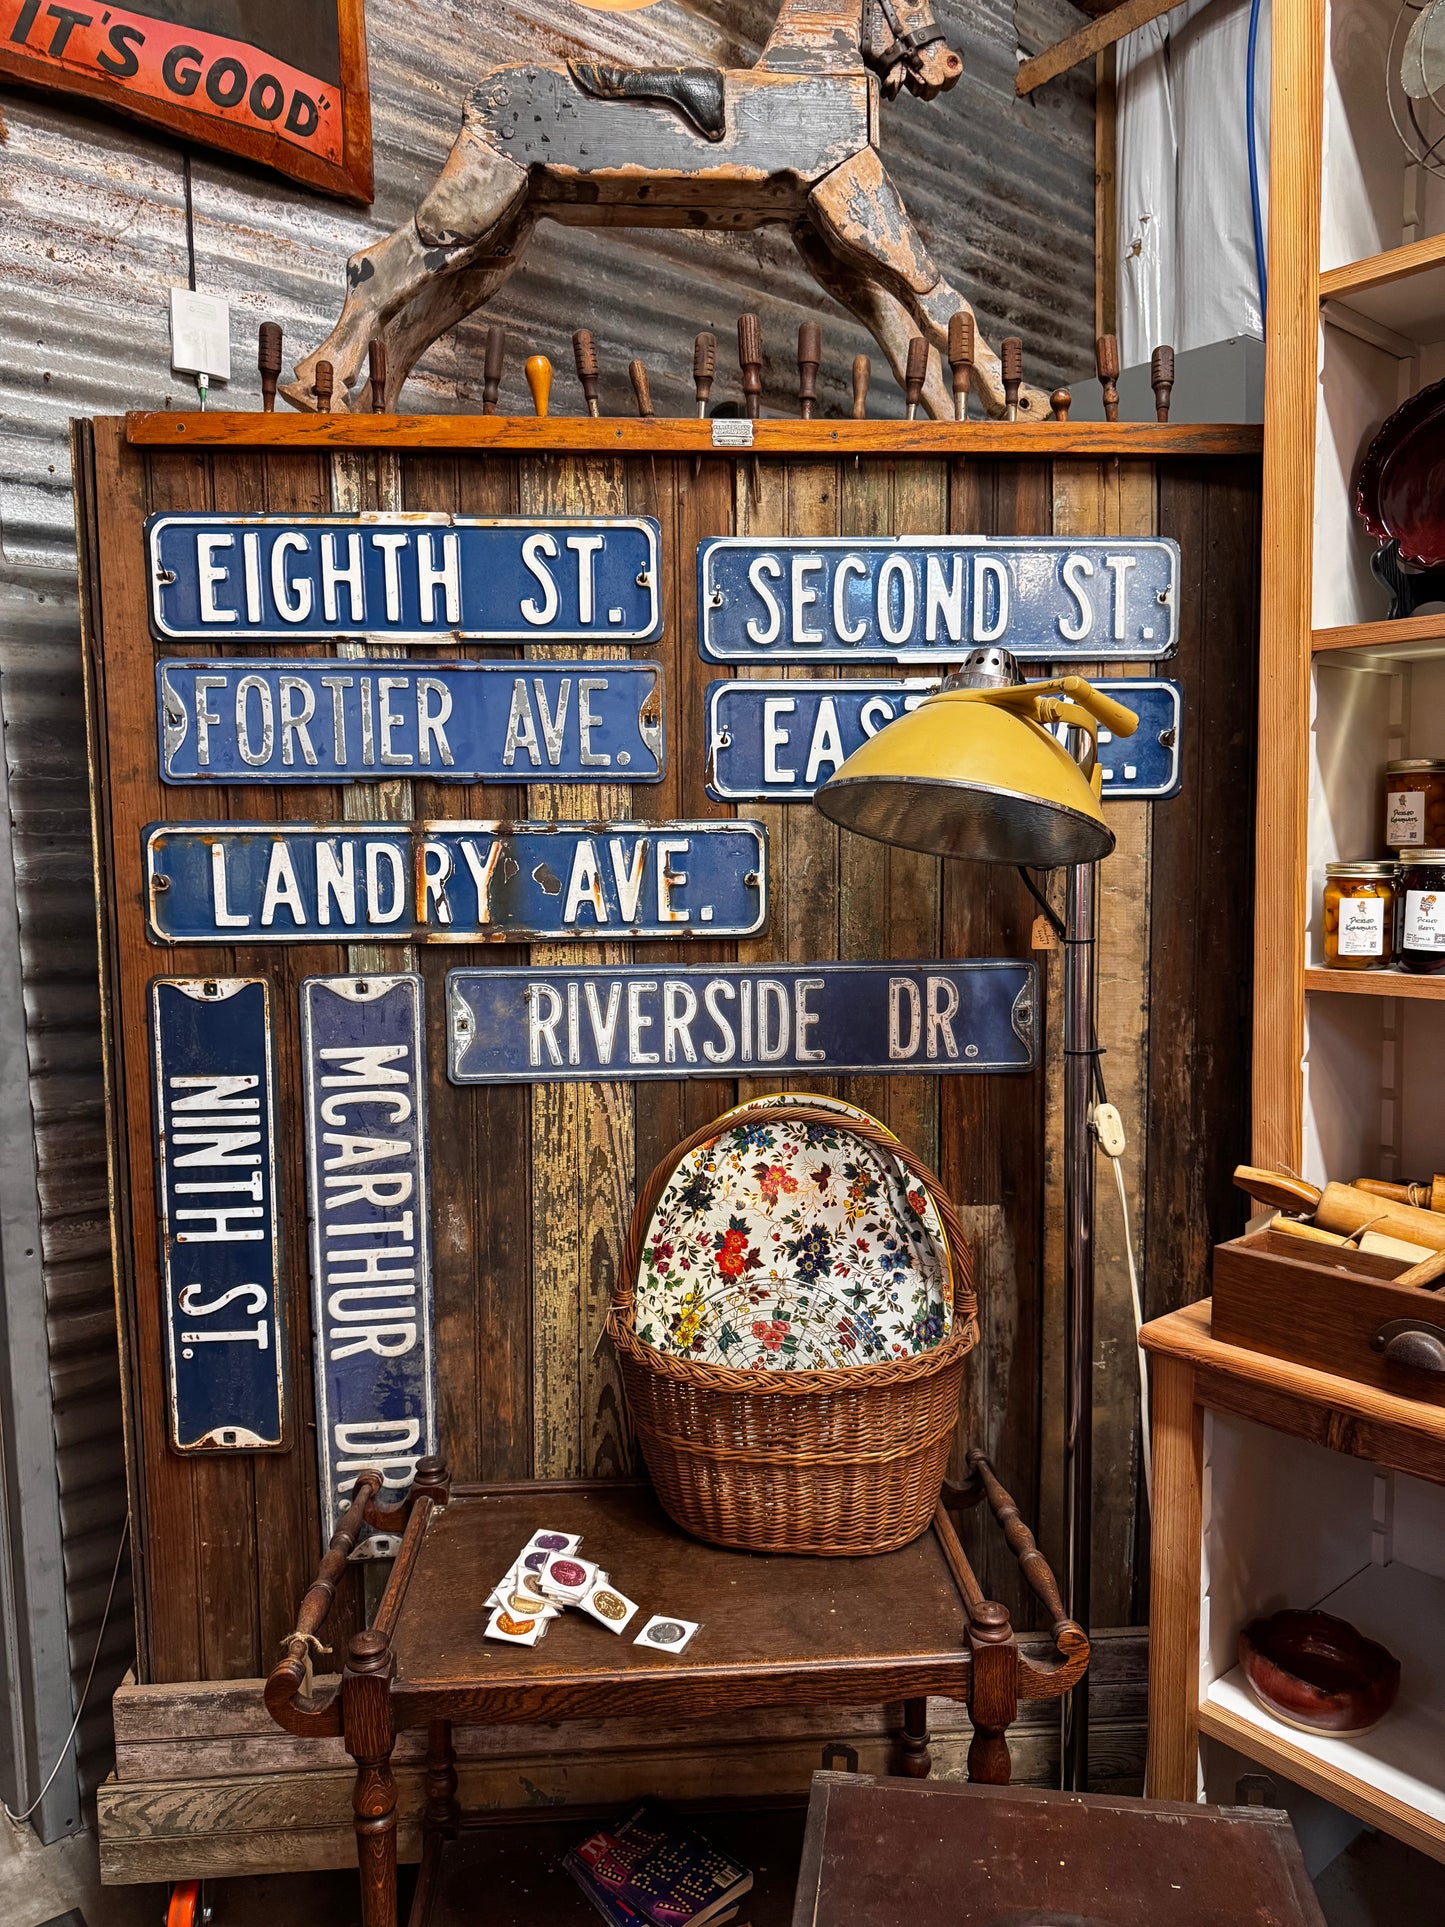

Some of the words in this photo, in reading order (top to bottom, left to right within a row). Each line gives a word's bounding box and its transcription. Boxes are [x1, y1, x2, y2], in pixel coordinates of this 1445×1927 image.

[9, 0, 146, 78] IT'S
[196, 532, 460, 623] EIGHTH
[520, 533, 624, 625] ST.
[745, 554, 1012, 645] SECOND
[1058, 553, 1155, 641] ST.
[195, 675, 455, 767] FORTIER
[502, 677, 632, 767] AVE.
[763, 696, 932, 783] EA
[211, 839, 502, 928] LANDRY
[563, 837, 714, 925] AVE.
[527, 978, 827, 1067] RIVERSIDE
[888, 976, 979, 1060] DR.
[169, 1075, 265, 1243] NINTH
[319, 1044, 418, 1361] MCARTHUR
[178, 1282, 269, 1361] ST.
[581, 1833, 609, 1855] TV
[594, 1827, 668, 1883] FALL
